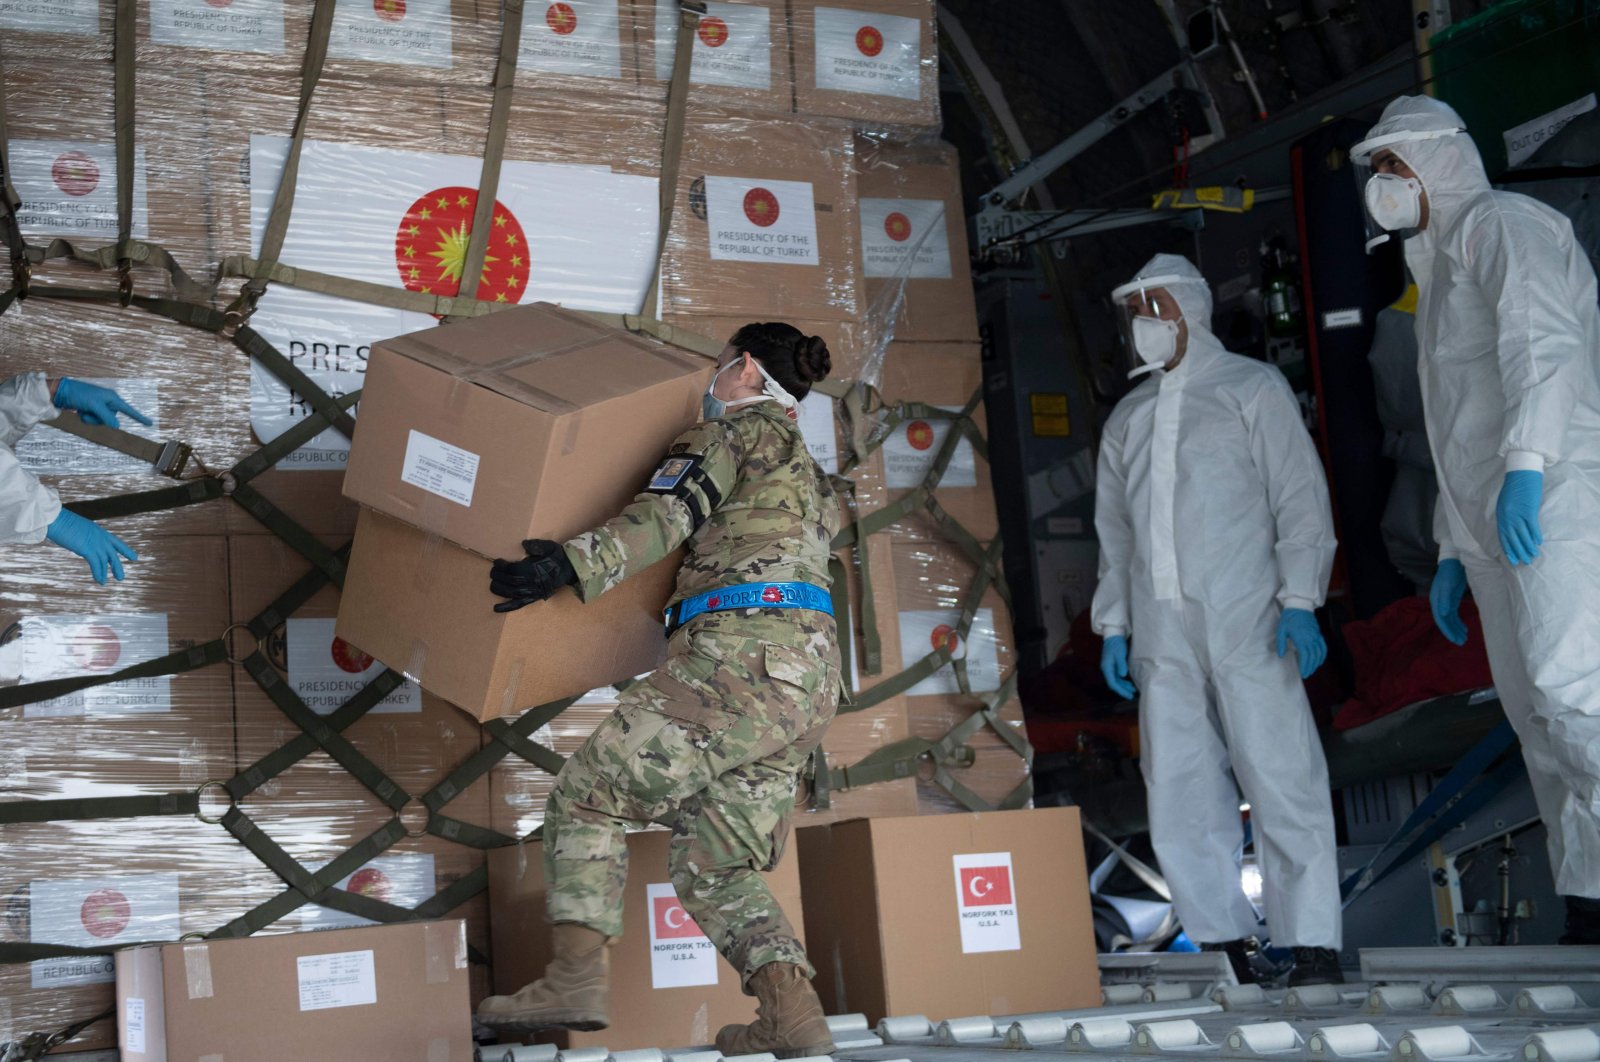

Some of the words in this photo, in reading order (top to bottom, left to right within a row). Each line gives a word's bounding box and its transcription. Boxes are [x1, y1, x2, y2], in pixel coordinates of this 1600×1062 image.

[173, 9, 228, 22] PRESIDENCY
[246, 16, 262, 26] THE
[174, 20, 215, 32] REPUBLIC
[217, 25, 229, 33] OF
[231, 26, 263, 36] TURKEY
[348, 24, 400, 36] PRESIDENCY
[402, 29, 413, 38] OF
[416, 31, 431, 39] THE
[348, 35, 386, 47] REPUBLIC
[388, 38, 401, 47] OF
[834, 57, 877, 69] PRESIDENCY
[834, 67, 867, 78] REPUBLIC
[1511, 134, 1531, 152] OUT
[1532, 128, 1545, 143] OF
[23, 200, 90, 213] RESIDENCY
[75, 218, 89, 227] OF
[718, 231, 775, 243] PRESIDENCY
[777, 234, 789, 243] OF
[792, 235, 809, 245] THE
[719, 243, 761, 255] REPUBLIC
[763, 246, 775, 256] OF
[777, 247, 811, 257] TURKEY
[810, 444, 827, 453] THE
[285, 451, 336, 463] REPUBLIC
[723, 590, 760, 607] PORT
[786, 589, 819, 602] DAWGS
[137, 678, 158, 688] THE
[962, 910, 997, 919] NORFORK
[999, 909, 1014, 917] TKS
[654, 942, 694, 952] NORFORK
[696, 941, 713, 949] TKS
[43, 963, 101, 979] REPUBLIC
